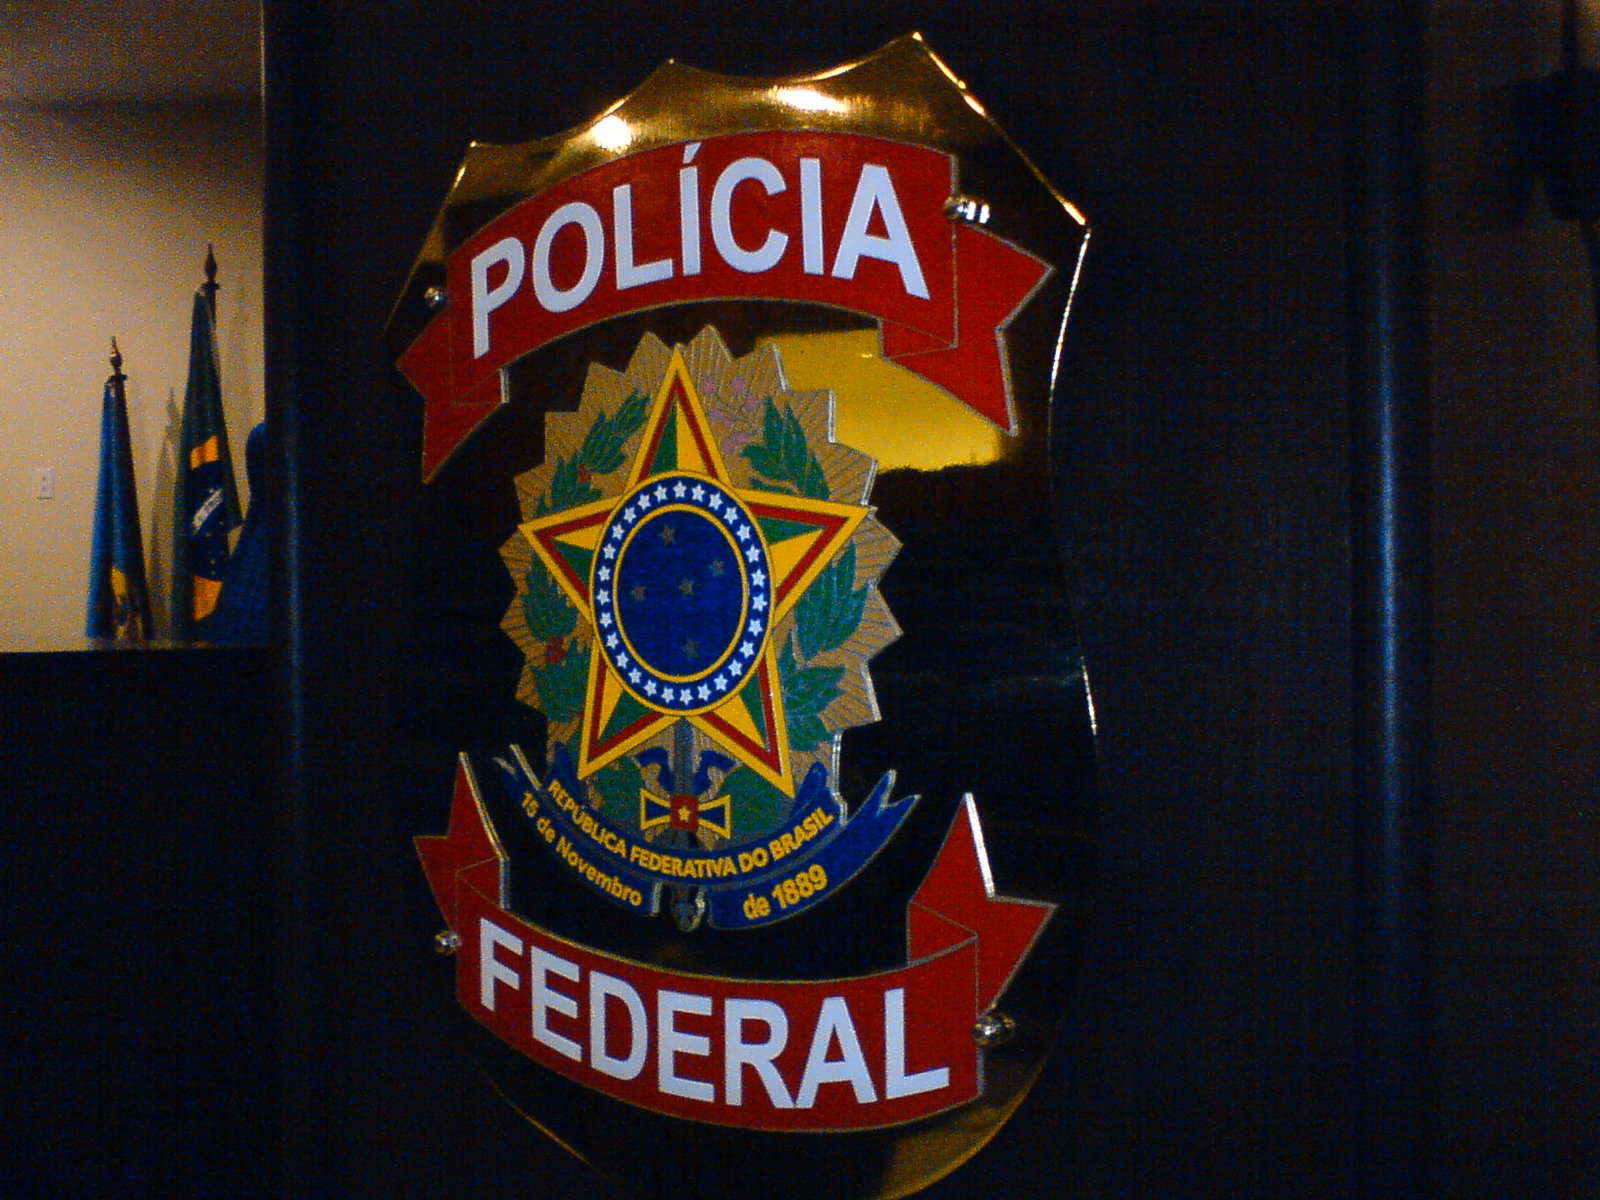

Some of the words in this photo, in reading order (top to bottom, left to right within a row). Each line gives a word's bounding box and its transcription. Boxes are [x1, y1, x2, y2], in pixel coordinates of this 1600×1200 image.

[471, 142, 930, 359] POLÍCIA
[522, 792, 539, 817] 15
[536, 817, 556, 843] de
[556, 836, 642, 906] Novembro
[548, 779, 626, 857] REPÚBLICA
[630, 845, 737, 878] FEDERATIVA
[739, 848, 769, 872] DO
[769, 808, 834, 860] BRASIL
[743, 893, 771, 919] de
[772, 864, 828, 909] 1889
[480, 917, 949, 1109] FEDERAL
